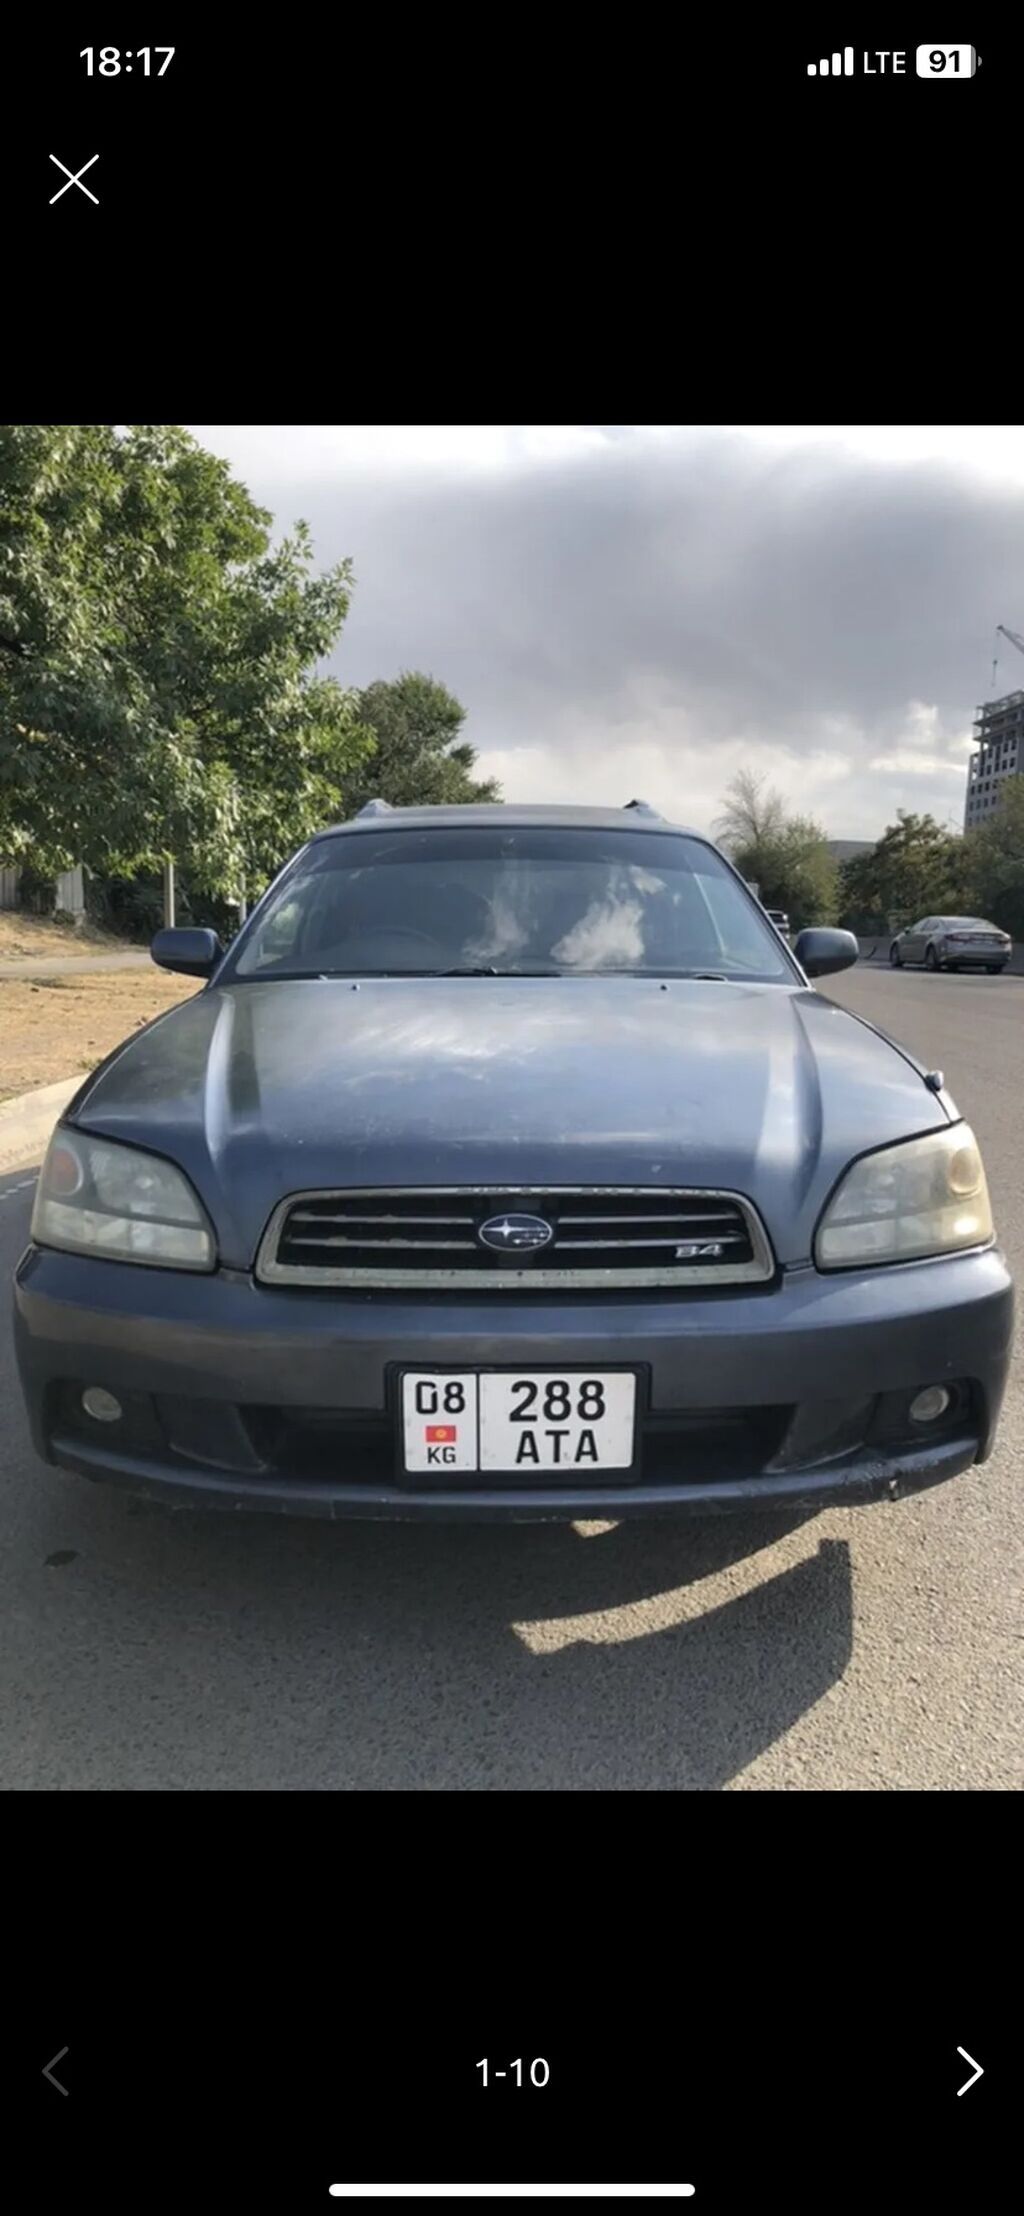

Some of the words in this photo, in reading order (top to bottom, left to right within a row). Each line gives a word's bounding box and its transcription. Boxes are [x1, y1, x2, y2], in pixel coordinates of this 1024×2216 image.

[675, 1244, 723, 1258] B4
[415, 1381, 466, 1415] 08
[509, 1380, 606, 1422] 288
[427, 1446, 456, 1464] KG
[515, 1429, 599, 1464] ATA
